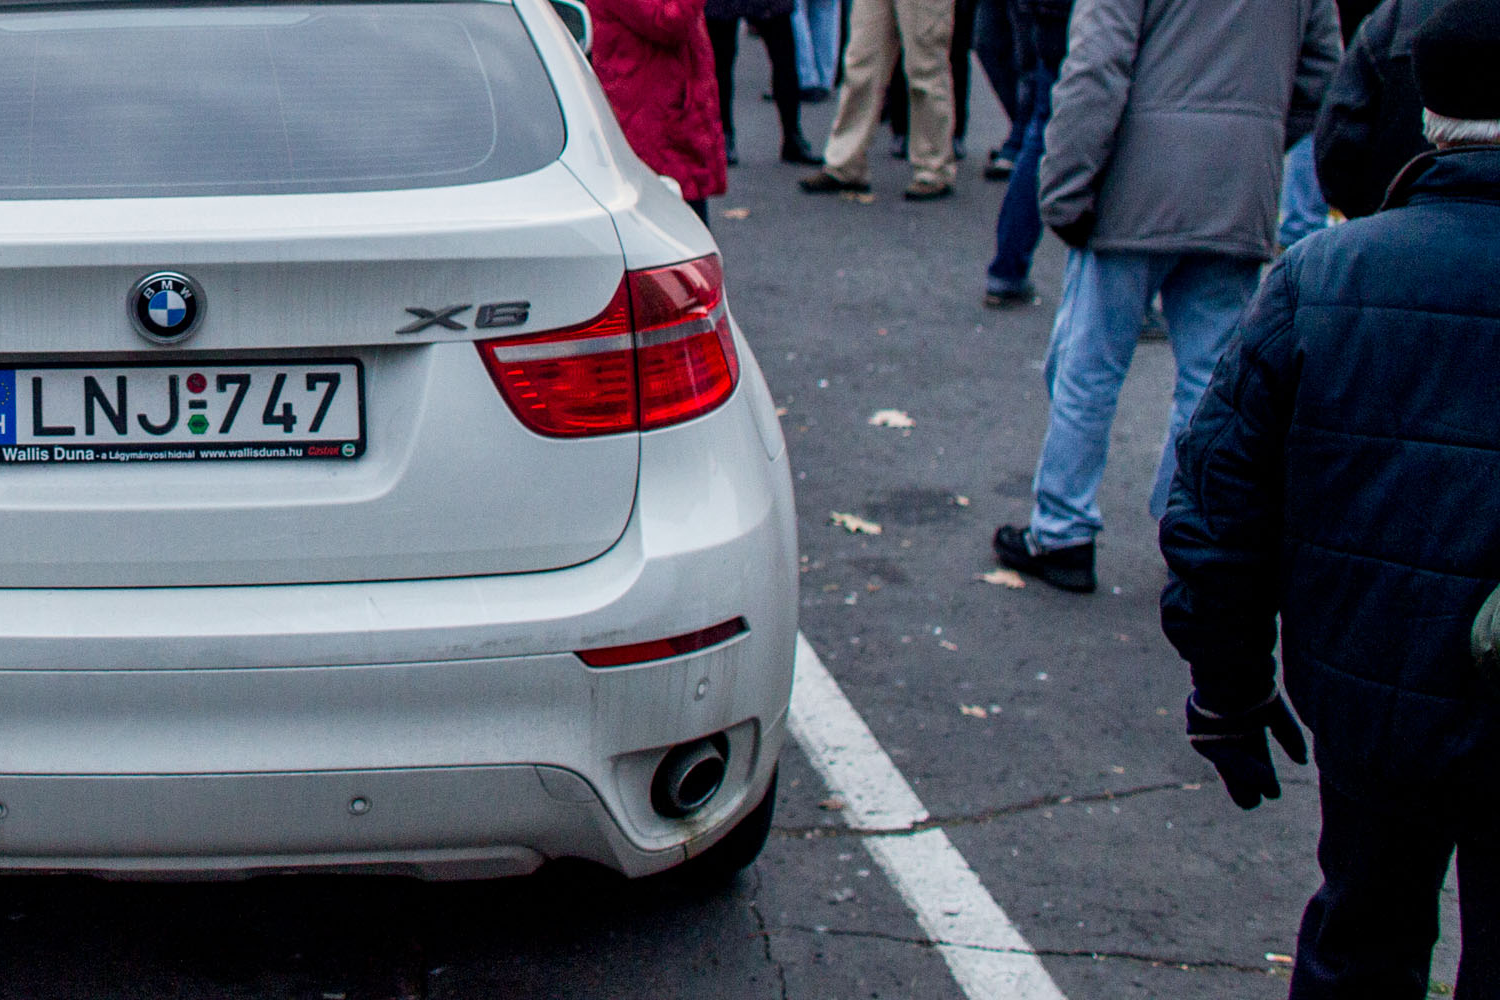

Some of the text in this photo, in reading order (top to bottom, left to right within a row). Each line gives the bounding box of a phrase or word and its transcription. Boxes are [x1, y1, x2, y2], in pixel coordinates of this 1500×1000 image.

[143, 280, 192, 300] BMW
[395, 301, 531, 334] X6
[2, 447, 50, 461] Wallis
[54, 446, 94, 460] Duna
[200, 447, 303, 459] www.wallisduna.hu
